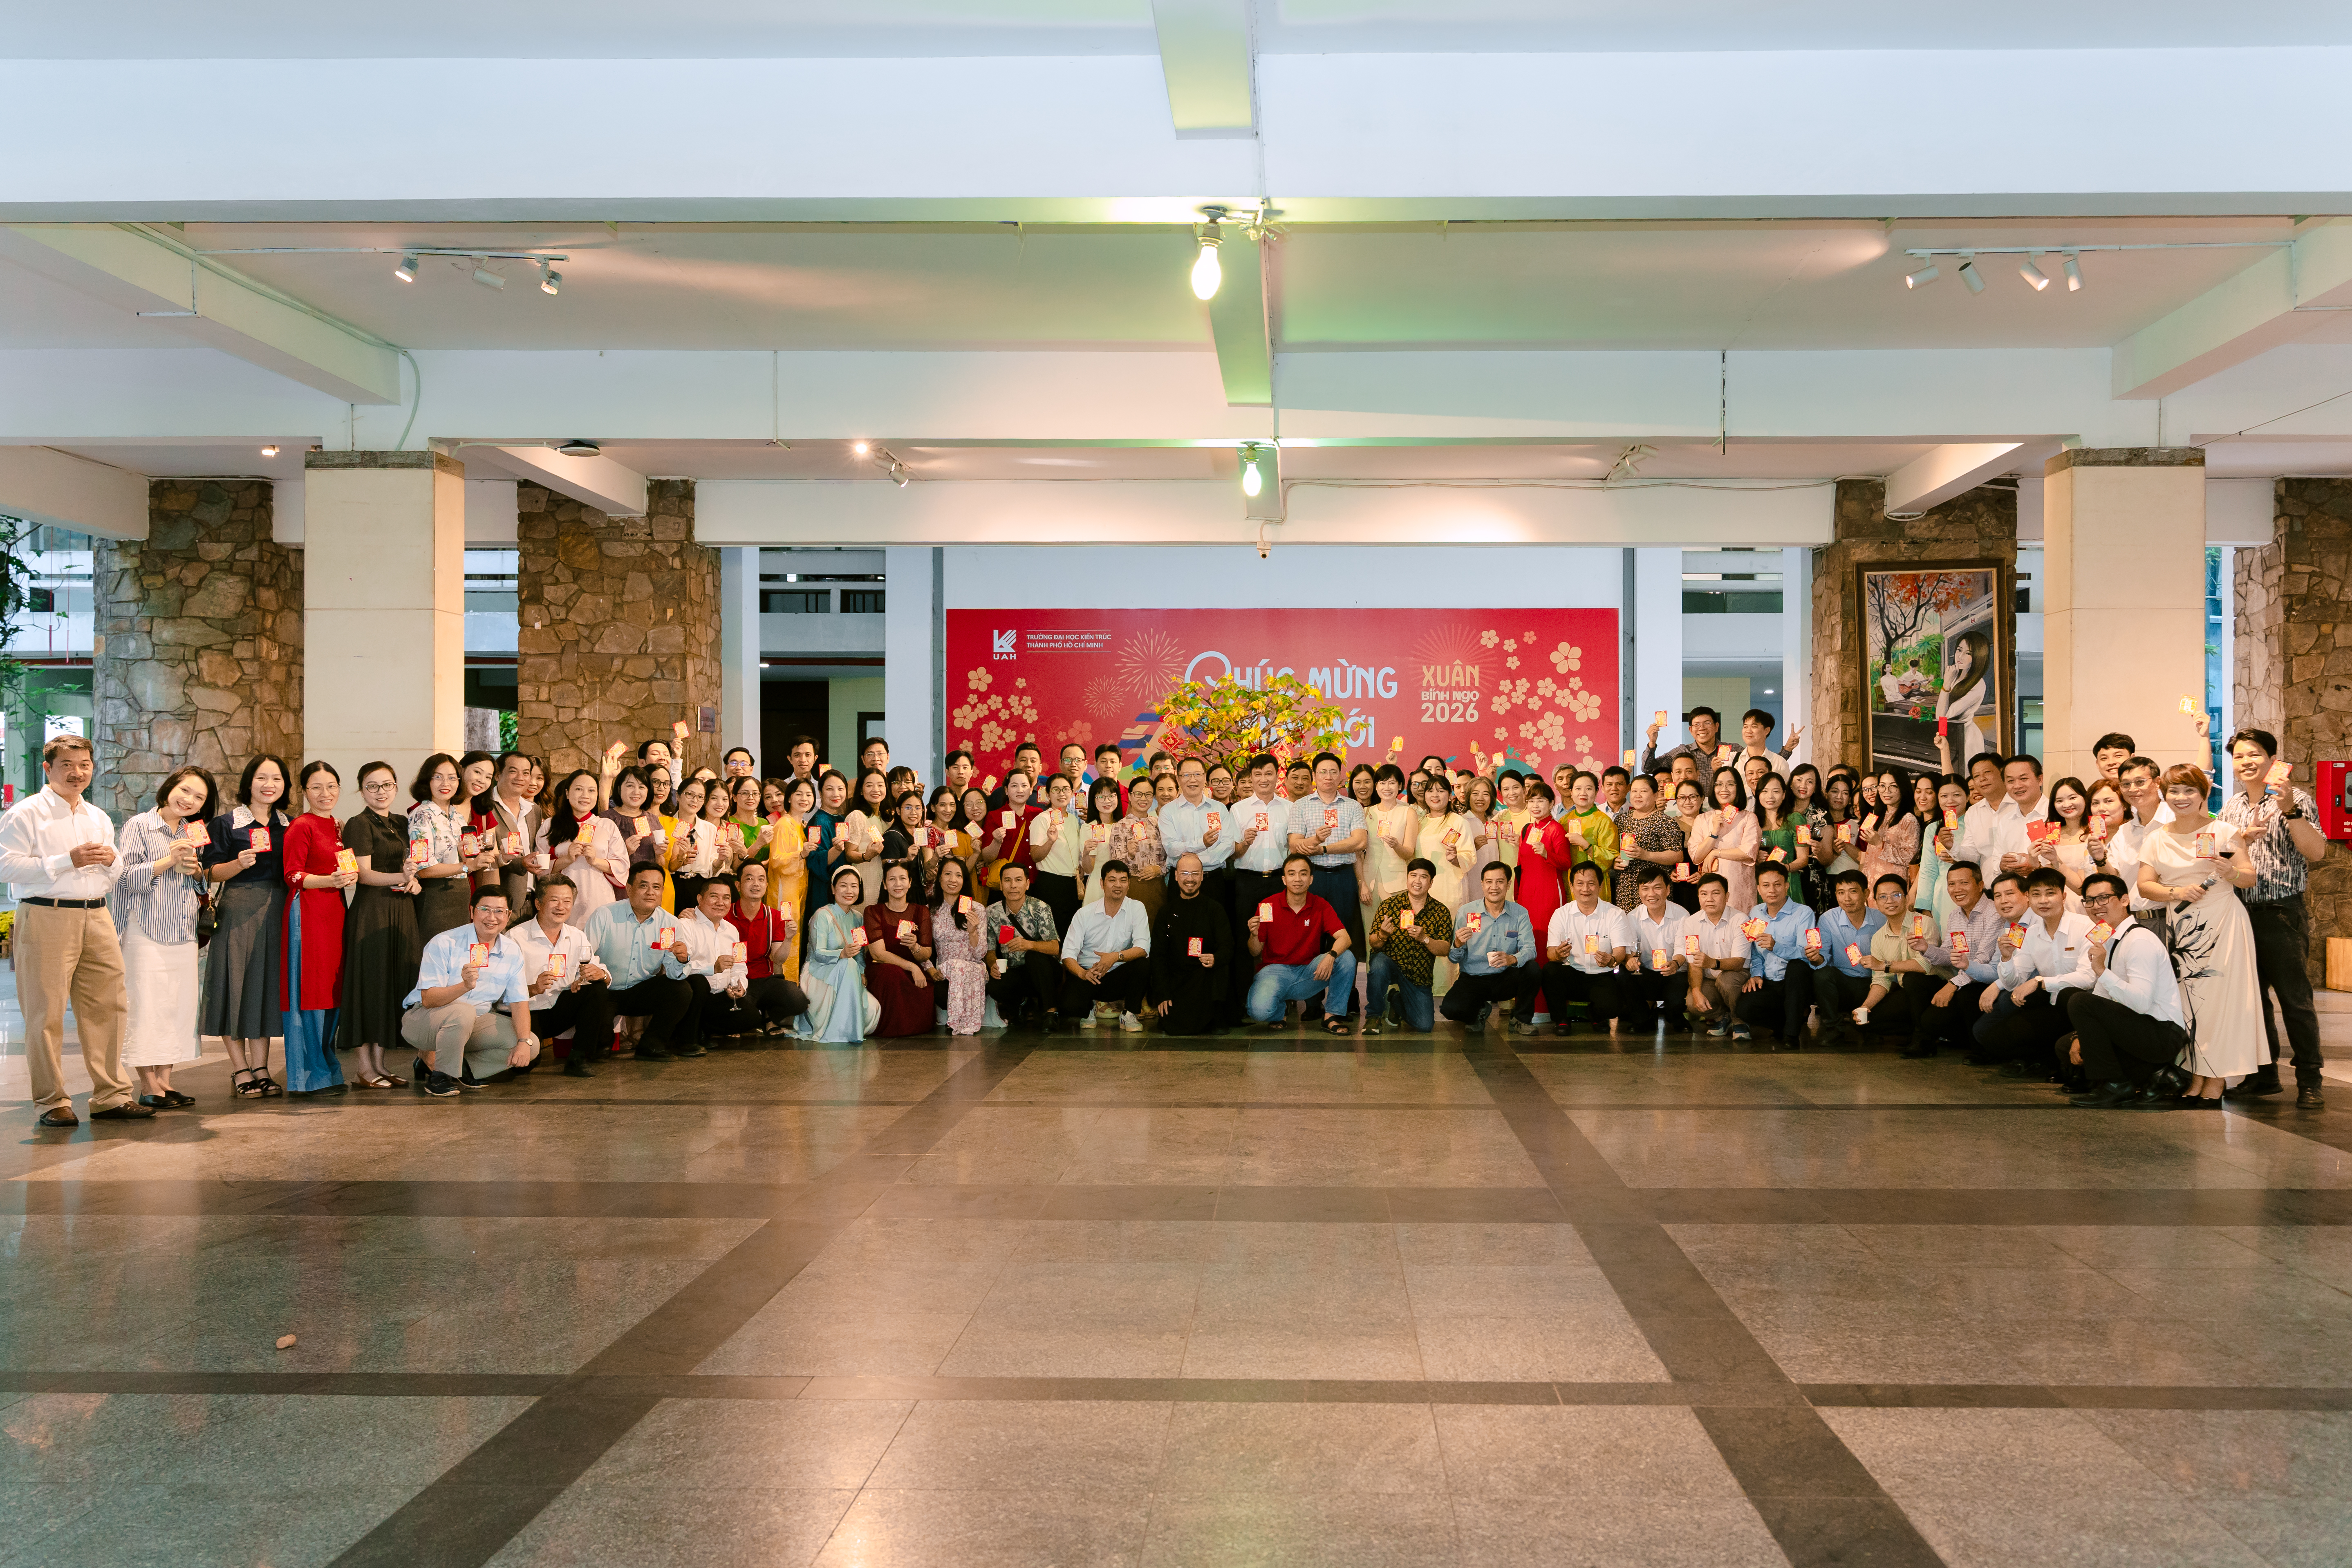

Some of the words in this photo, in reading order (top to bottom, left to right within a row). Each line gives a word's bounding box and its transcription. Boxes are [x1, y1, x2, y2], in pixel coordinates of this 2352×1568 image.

[1308, 659, 1398, 699] MỪNG
[1422, 659, 1479, 687] XUÂN
[1421, 702, 1479, 722] 2026
